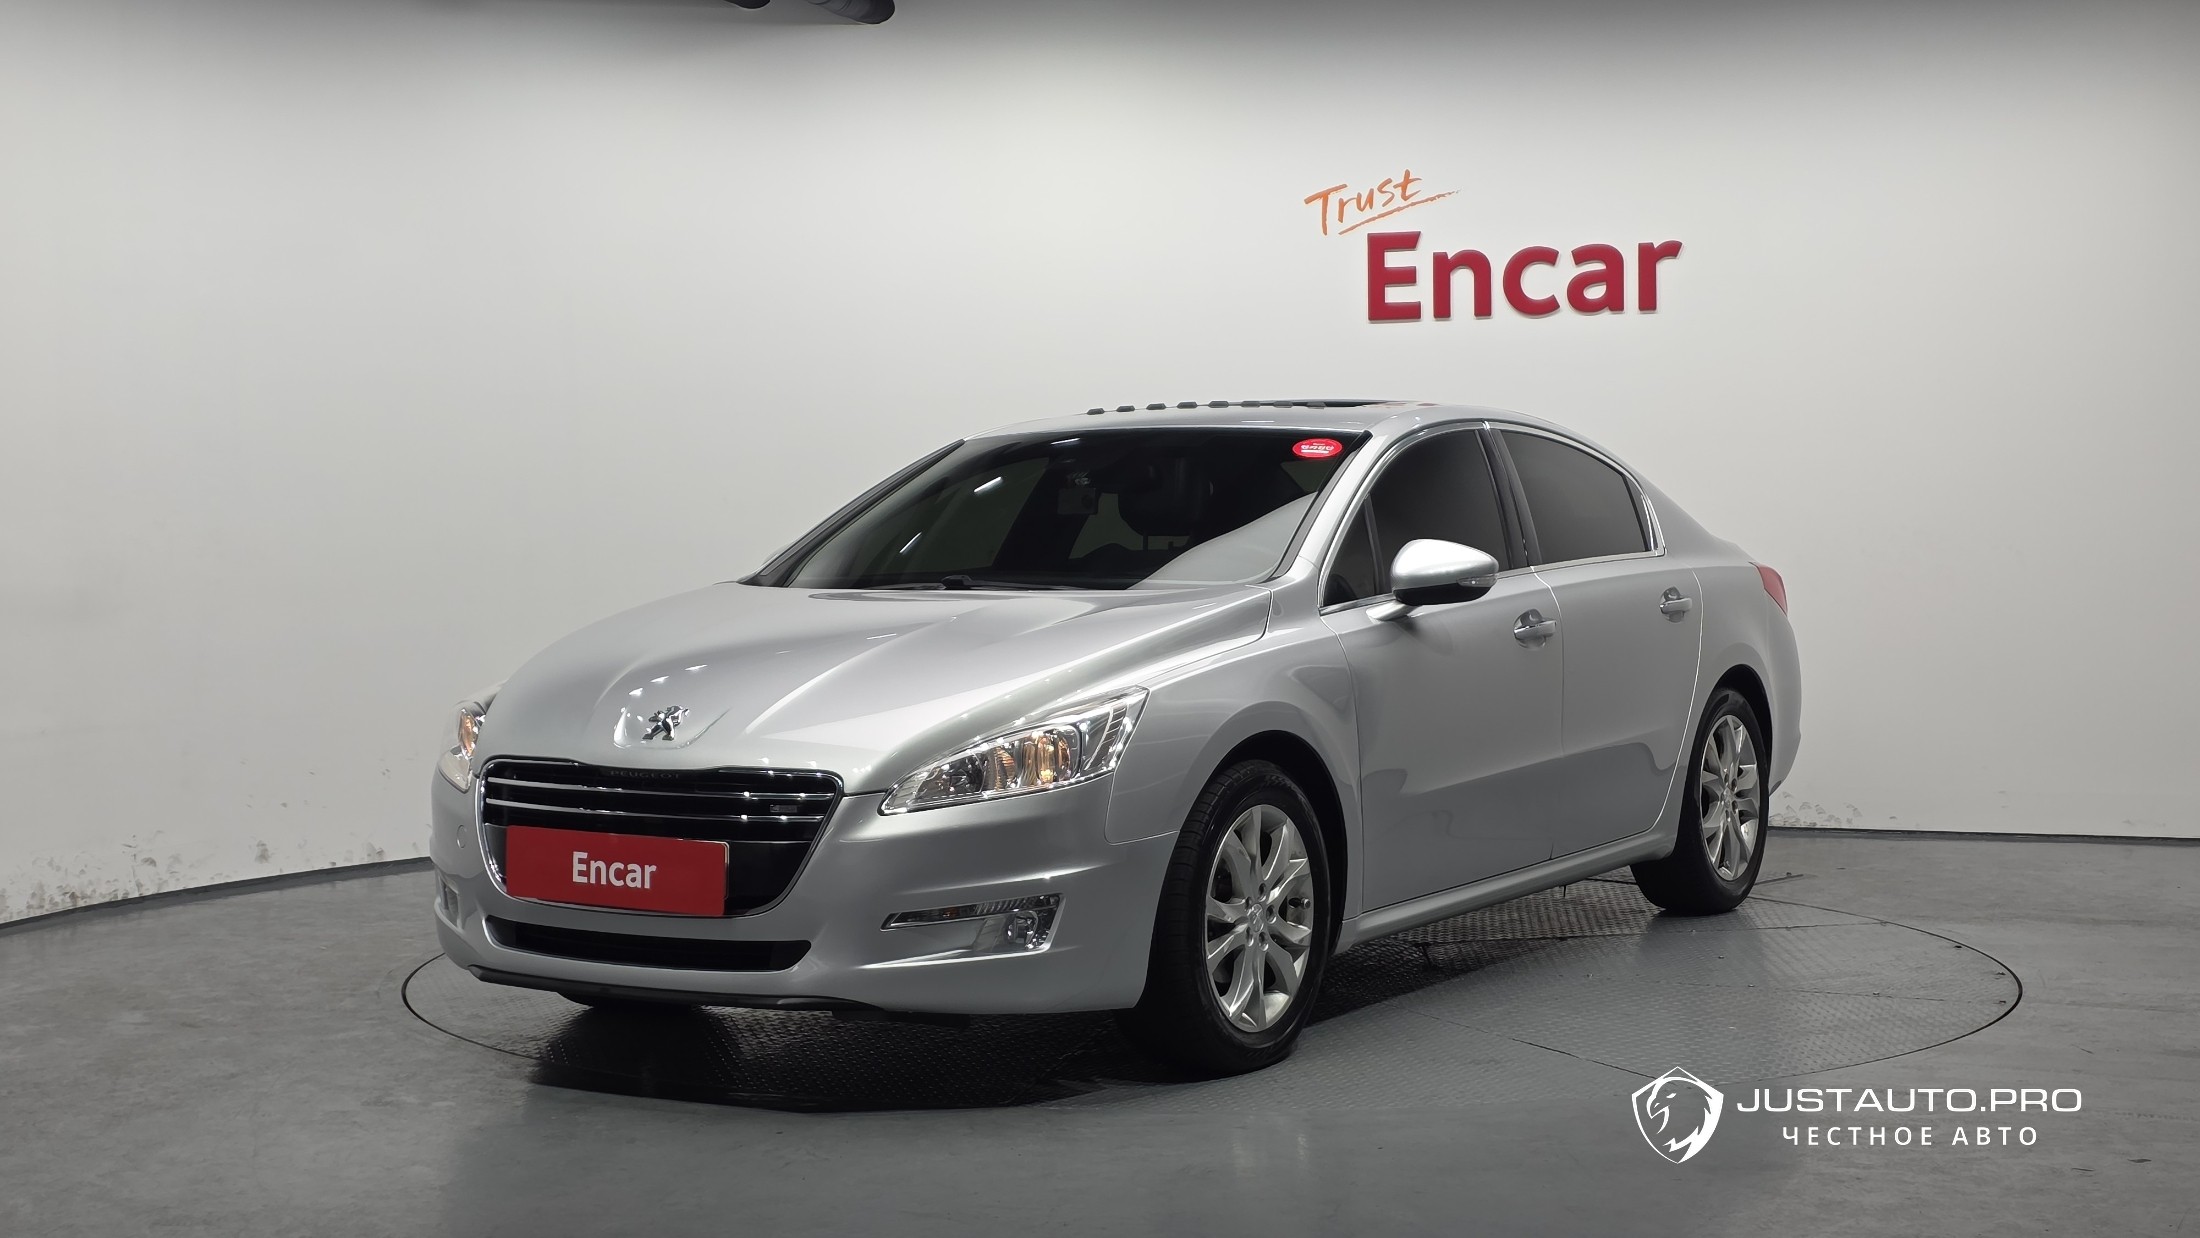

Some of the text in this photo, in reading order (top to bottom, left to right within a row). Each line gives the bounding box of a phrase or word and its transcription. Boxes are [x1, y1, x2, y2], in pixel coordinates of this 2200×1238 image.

[1304, 169, 1421, 236] Trust
[1367, 231, 1682, 321] Encar
[571, 851, 657, 889] Encar
